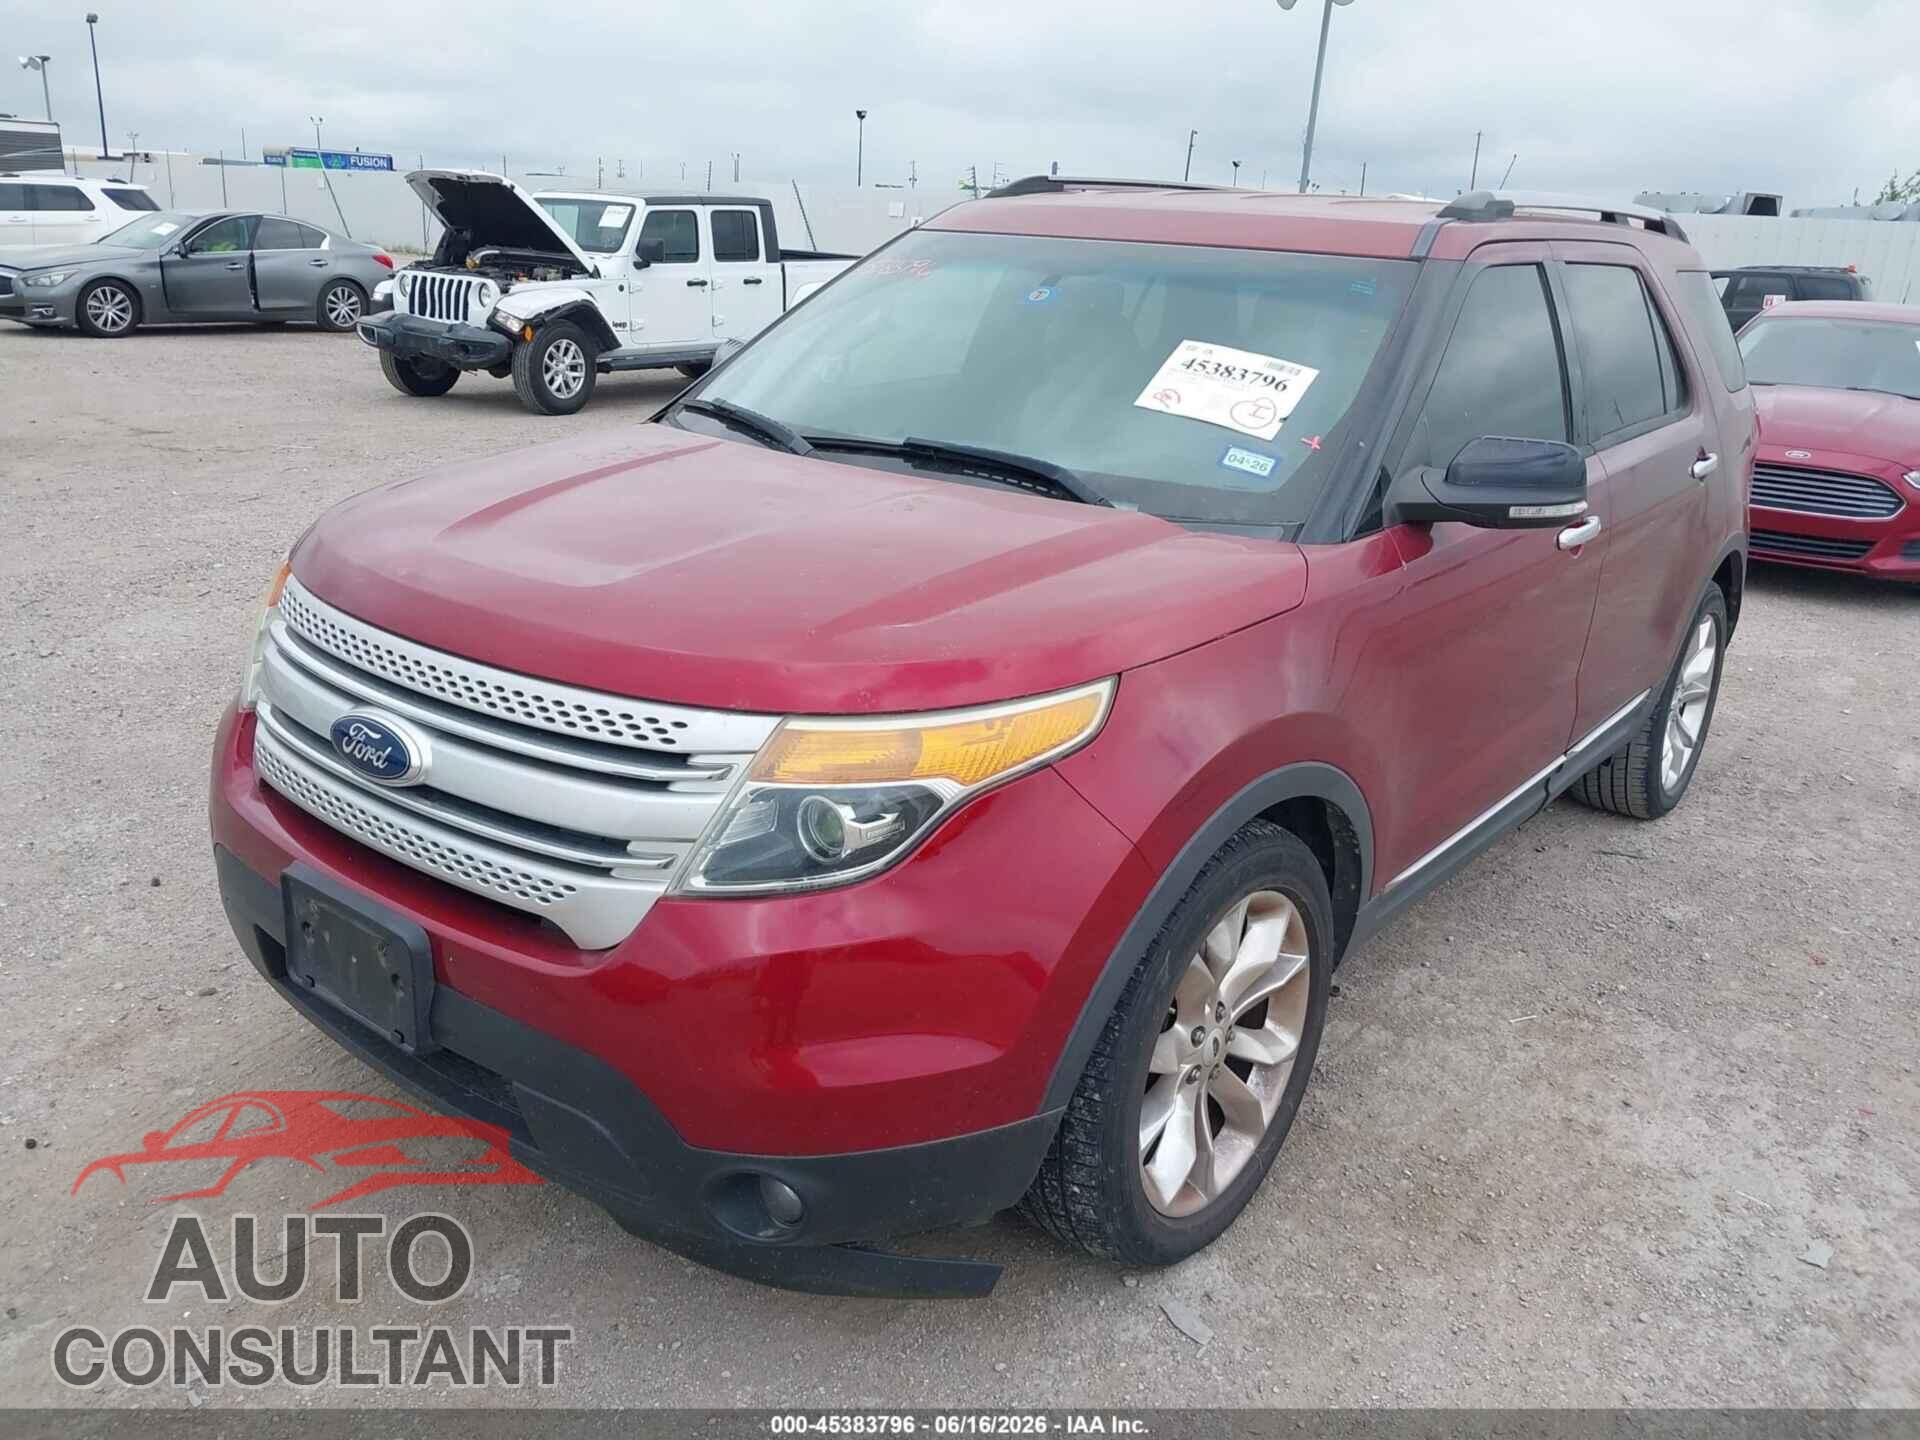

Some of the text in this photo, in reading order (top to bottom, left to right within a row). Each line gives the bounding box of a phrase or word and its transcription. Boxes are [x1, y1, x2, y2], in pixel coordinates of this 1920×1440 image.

[350, 156, 388, 169] FUSION
[1181, 358, 1290, 392] 45383796
[342, 722, 392, 769] Ford
